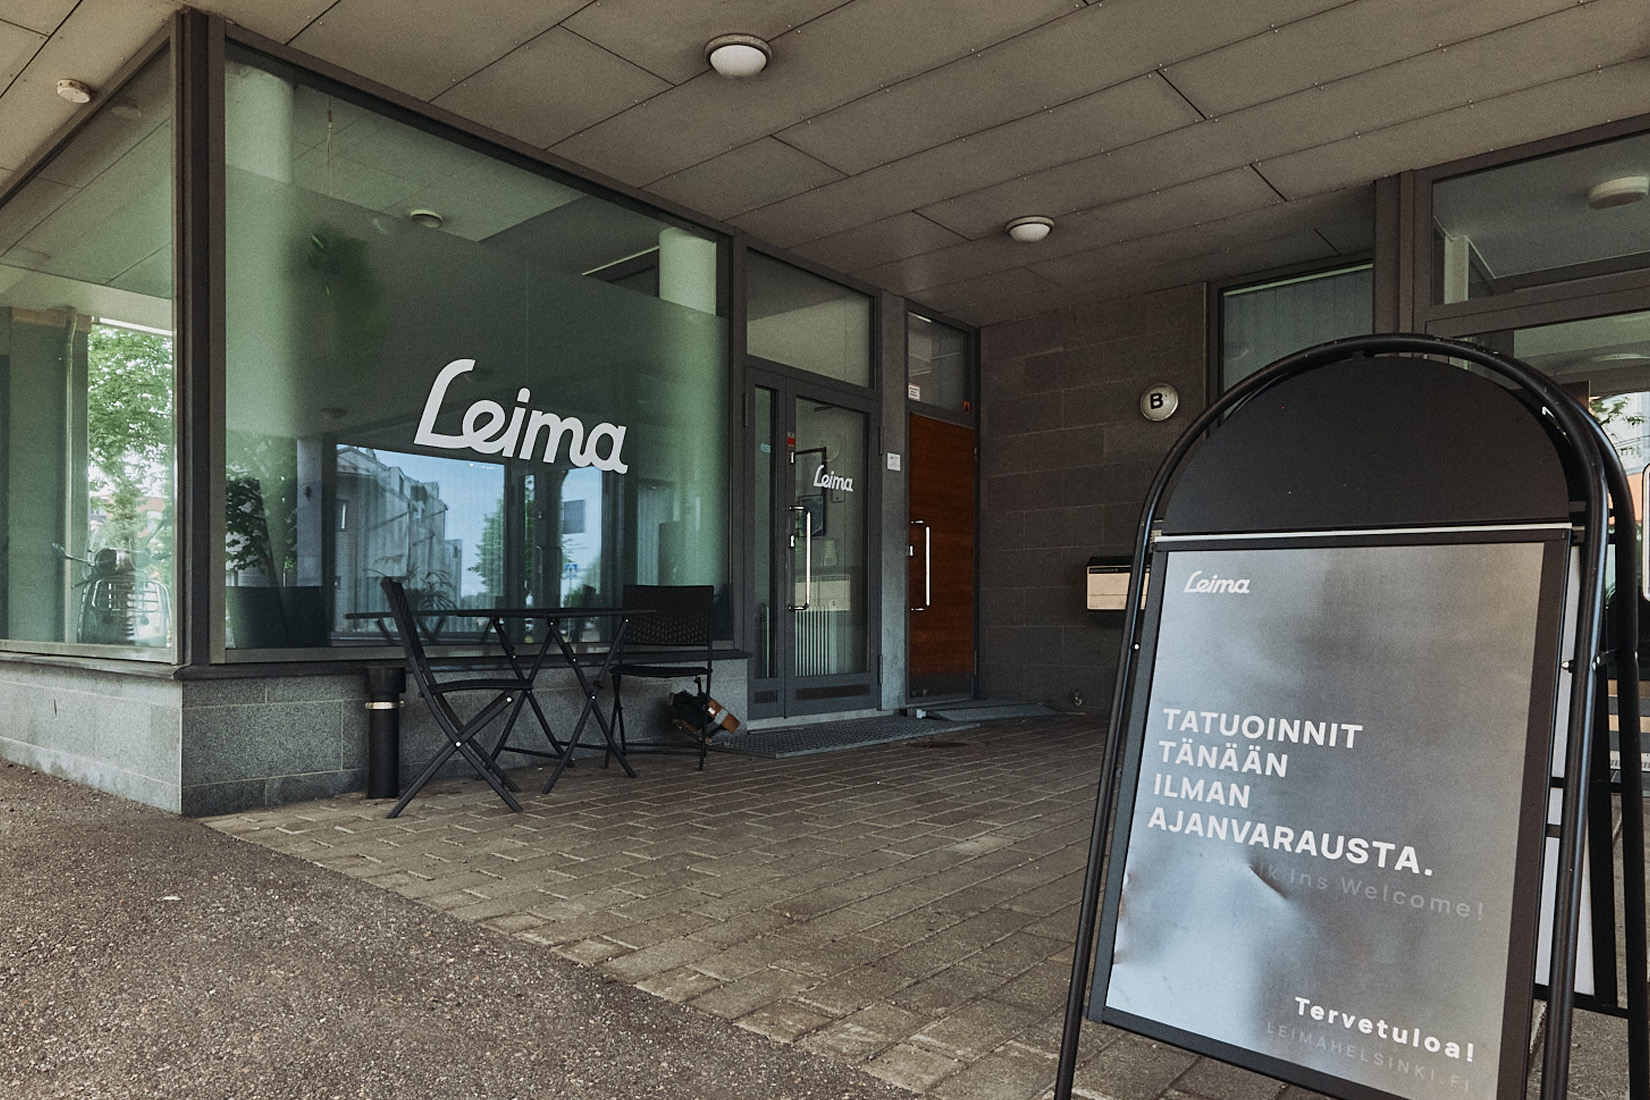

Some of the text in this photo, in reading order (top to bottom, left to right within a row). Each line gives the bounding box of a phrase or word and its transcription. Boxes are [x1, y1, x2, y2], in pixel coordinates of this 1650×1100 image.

[414, 358, 629, 475] Leima
[1150, 392, 1164, 410] B
[813, 464, 854, 492] Leima
[1184, 570, 1251, 594] Leima
[1162, 708, 1364, 749] TATUOINNIT
[1158, 737, 1289, 778] TÄNÄÄN
[1153, 773, 1251, 809] ILMAN
[1147, 806, 1433, 877] AJANVARAUSTA.
[1340, 876, 1485, 921] Welcome!
[1294, 996, 1475, 1063] Tervetuloa!
